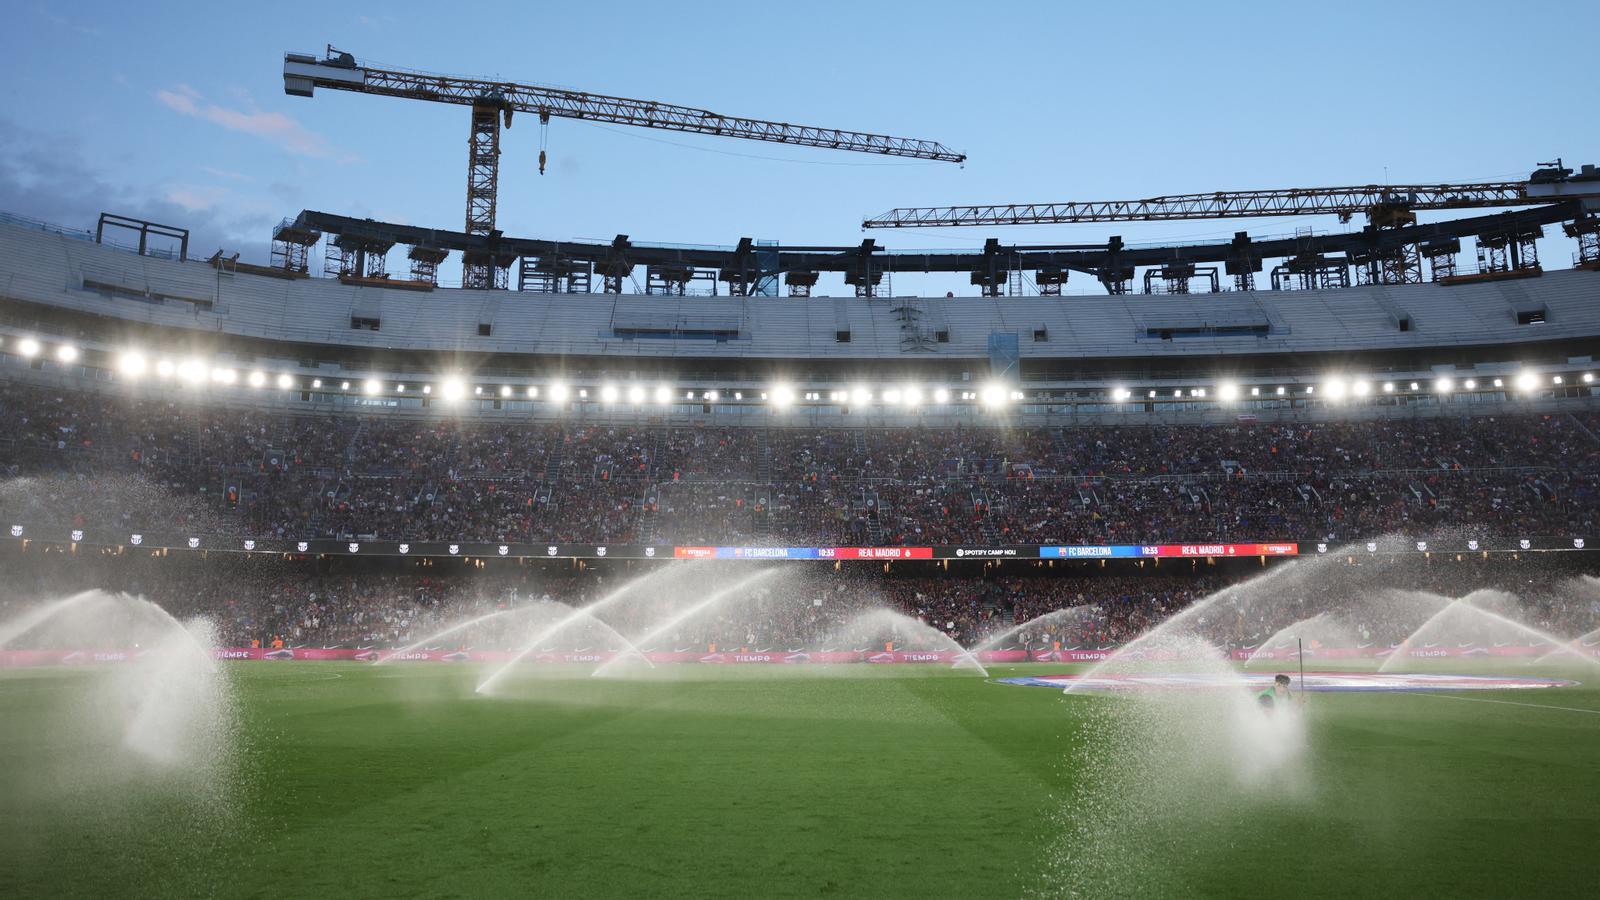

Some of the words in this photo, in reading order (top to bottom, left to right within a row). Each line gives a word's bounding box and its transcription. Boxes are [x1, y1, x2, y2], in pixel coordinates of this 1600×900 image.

[744, 548, 755, 557] FC
[756, 548, 788, 557] BARCELONA
[858, 548, 874, 557] REAL
[875, 548, 900, 557] MADRID
[1068, 547, 1076, 556] FC
[1077, 547, 1112, 556] BARCELONA
[1181, 545, 1198, 555] REAL
[1199, 545, 1225, 555] MADRID
